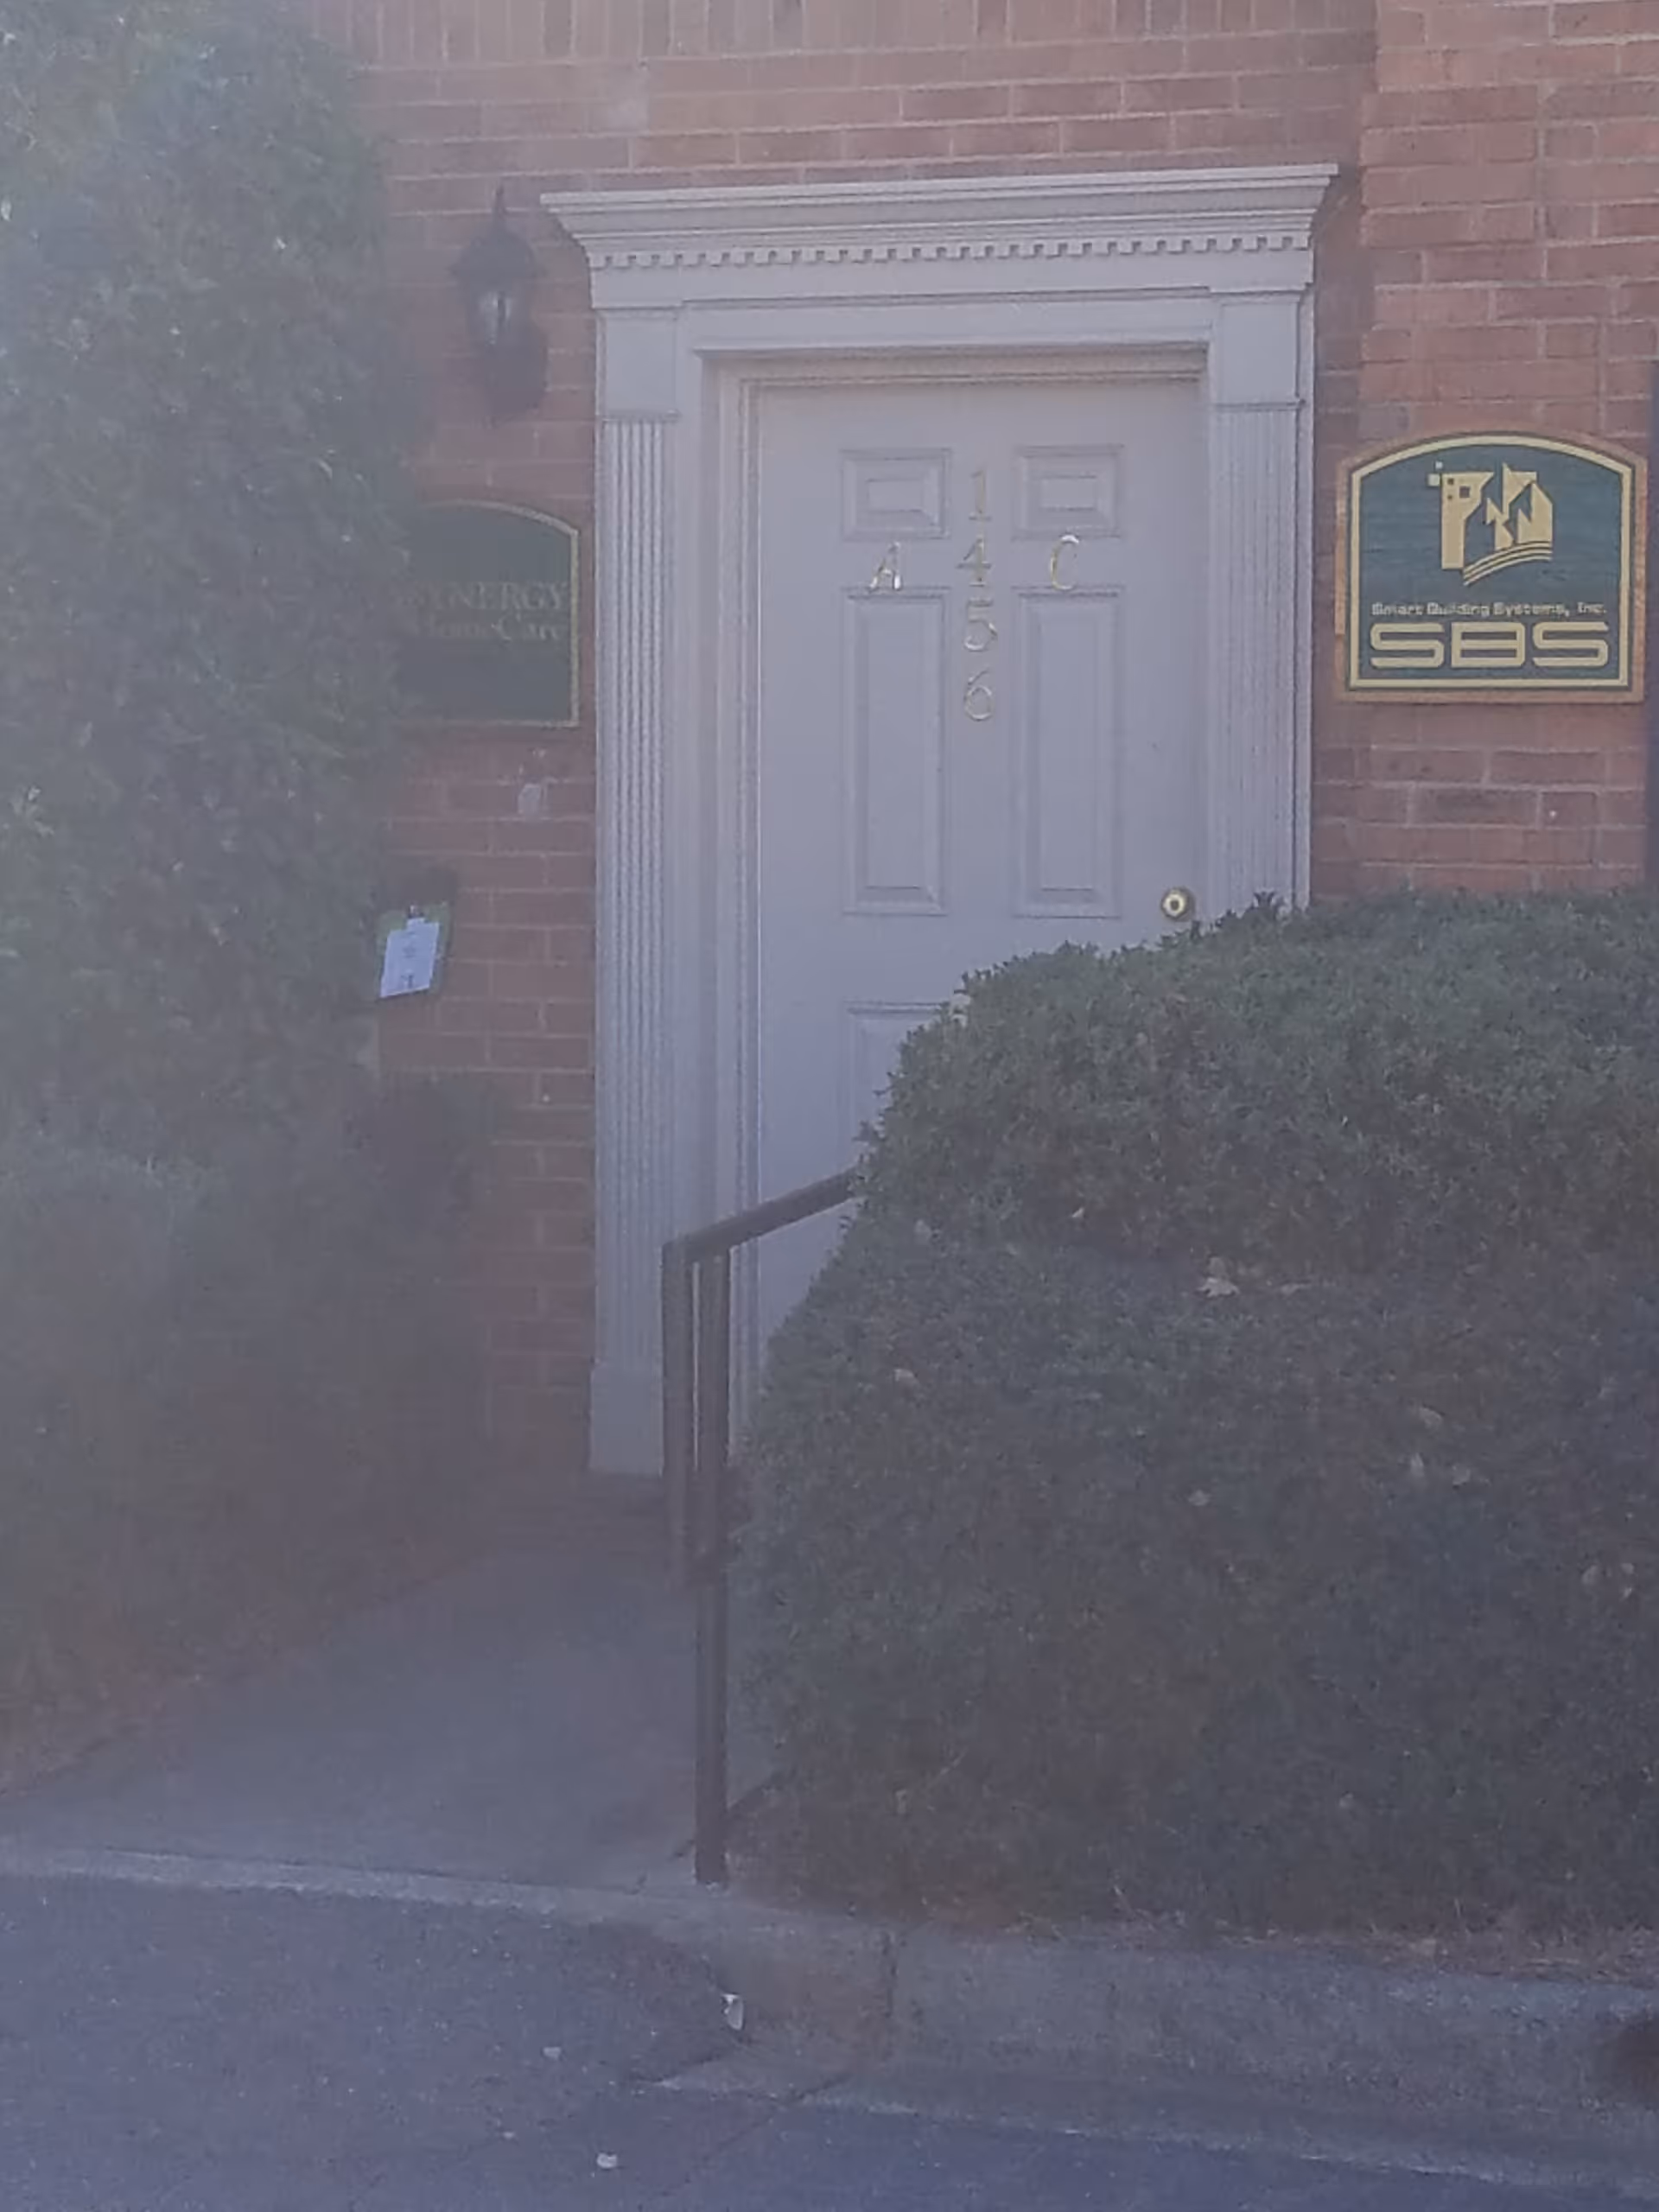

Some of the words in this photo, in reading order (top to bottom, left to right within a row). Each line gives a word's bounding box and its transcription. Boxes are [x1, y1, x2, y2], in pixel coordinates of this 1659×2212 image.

[868, 539, 901, 593] A
[1049, 531, 1080, 591] C
[1370, 621, 1609, 669] SBS
